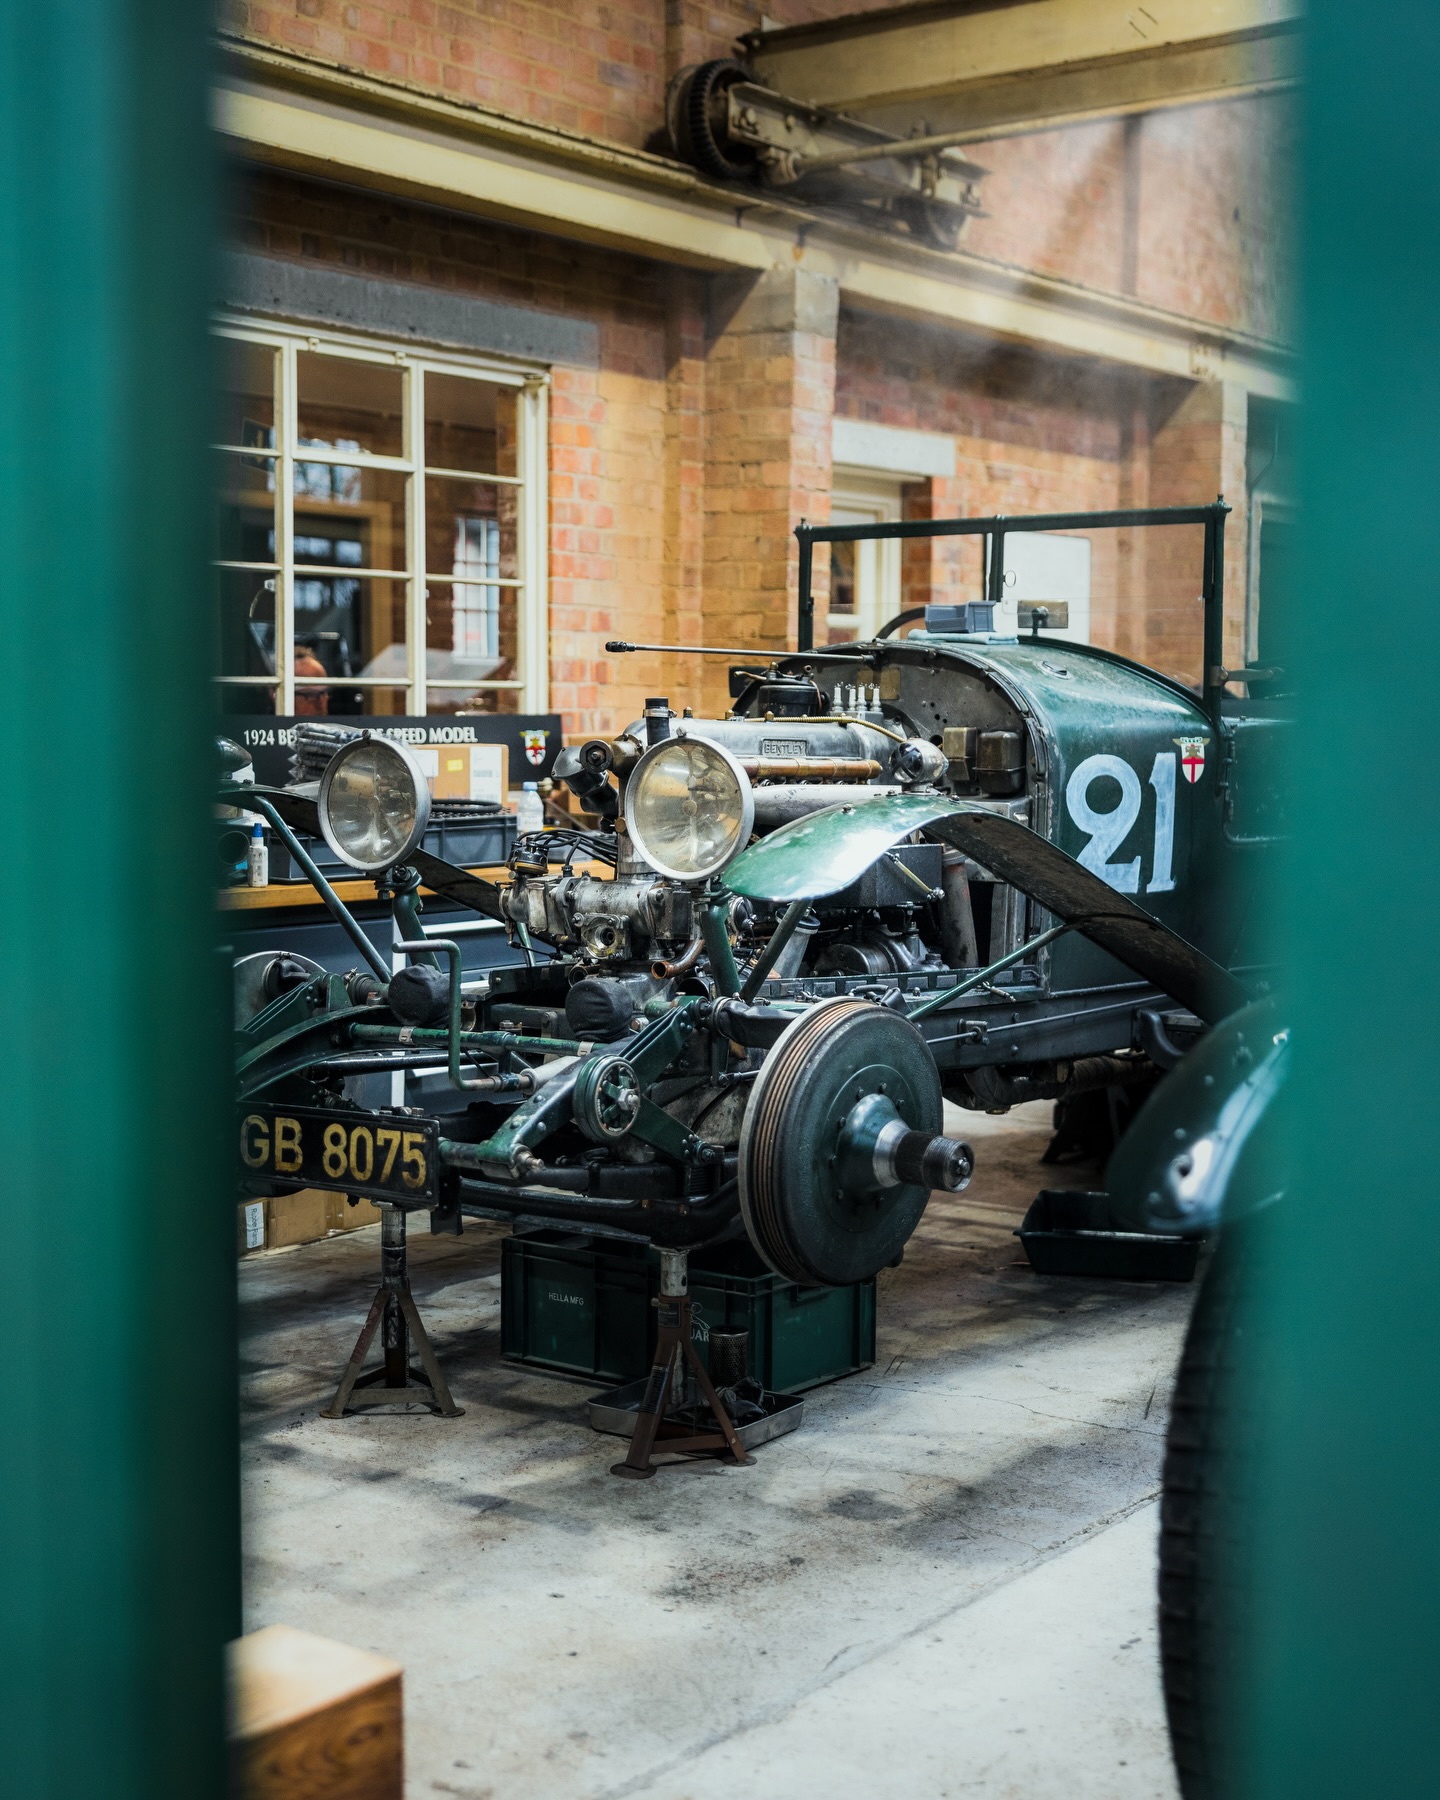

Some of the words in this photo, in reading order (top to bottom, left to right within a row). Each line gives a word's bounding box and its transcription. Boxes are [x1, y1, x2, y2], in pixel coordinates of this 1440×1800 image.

[244, 729, 275, 746] 1924
[429, 727, 478, 743] MODEL
[763, 743, 805, 755] BENTLEY
[1066, 752, 1177, 894] 21
[240, 1114, 303, 1172] GB
[322, 1123, 427, 1189] 8075
[548, 1292, 569, 1303] HELLA
[570, 1295, 584, 1306] MFG
